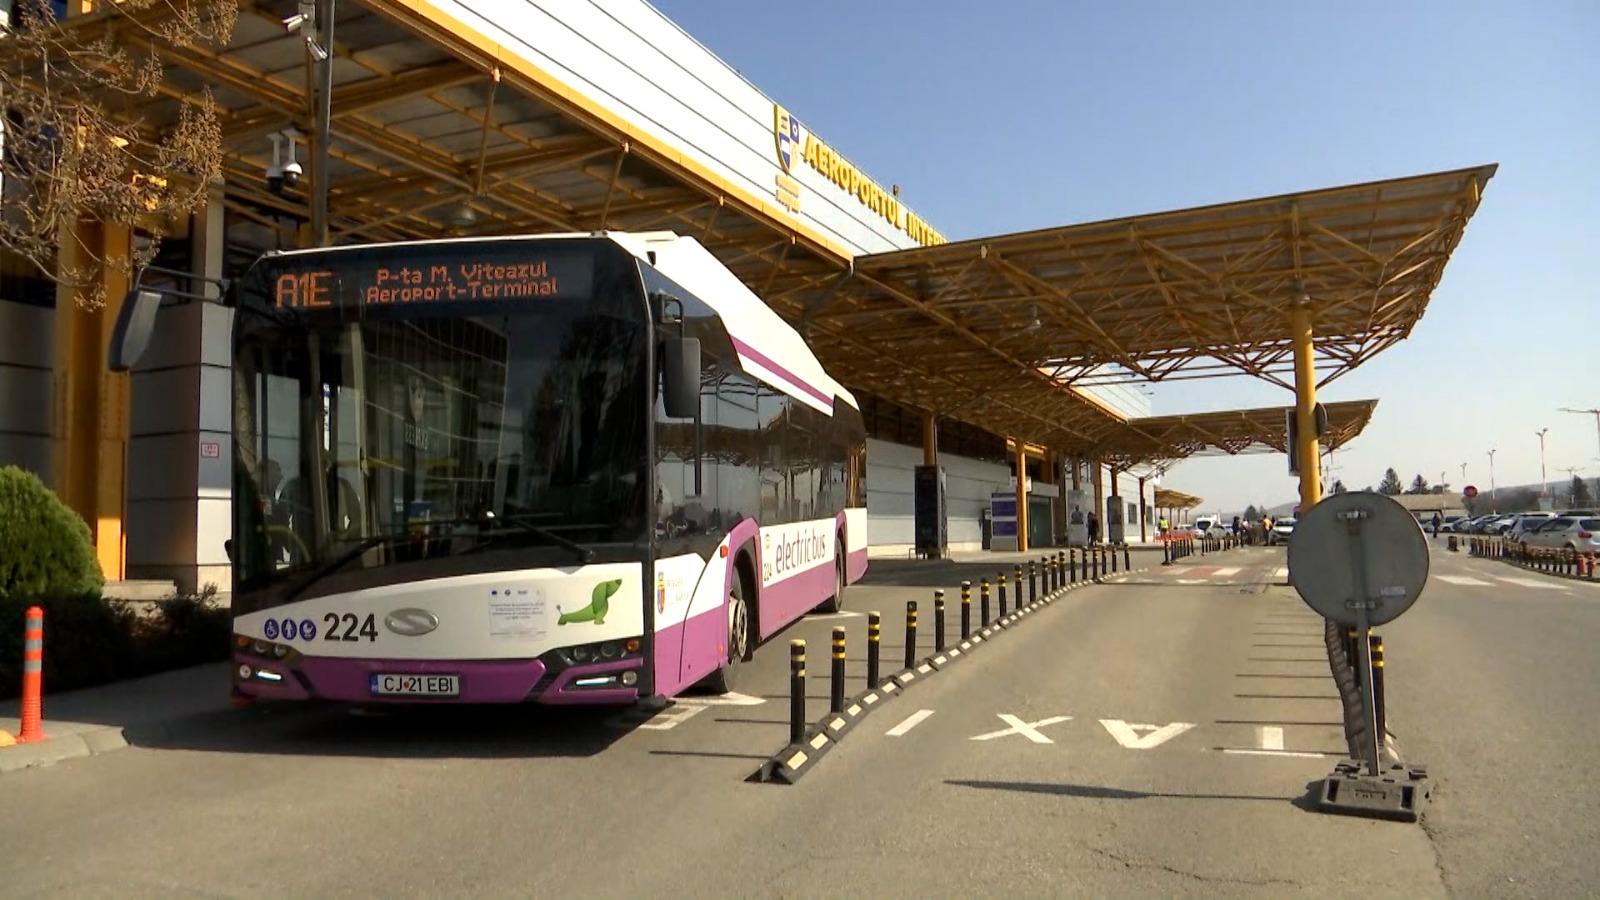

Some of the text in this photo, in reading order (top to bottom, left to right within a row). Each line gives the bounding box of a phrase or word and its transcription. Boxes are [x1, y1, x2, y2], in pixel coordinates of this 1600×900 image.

[804, 132, 905, 229] AEROPORTUL
[377, 261, 548, 284] P-ta M. Viteazul
[276, 271, 332, 308] A1E
[367, 278, 558, 303] Aeroport-Terminal
[324, 612, 378, 642] 224
[885, 709, 1325, 758] TAXI
